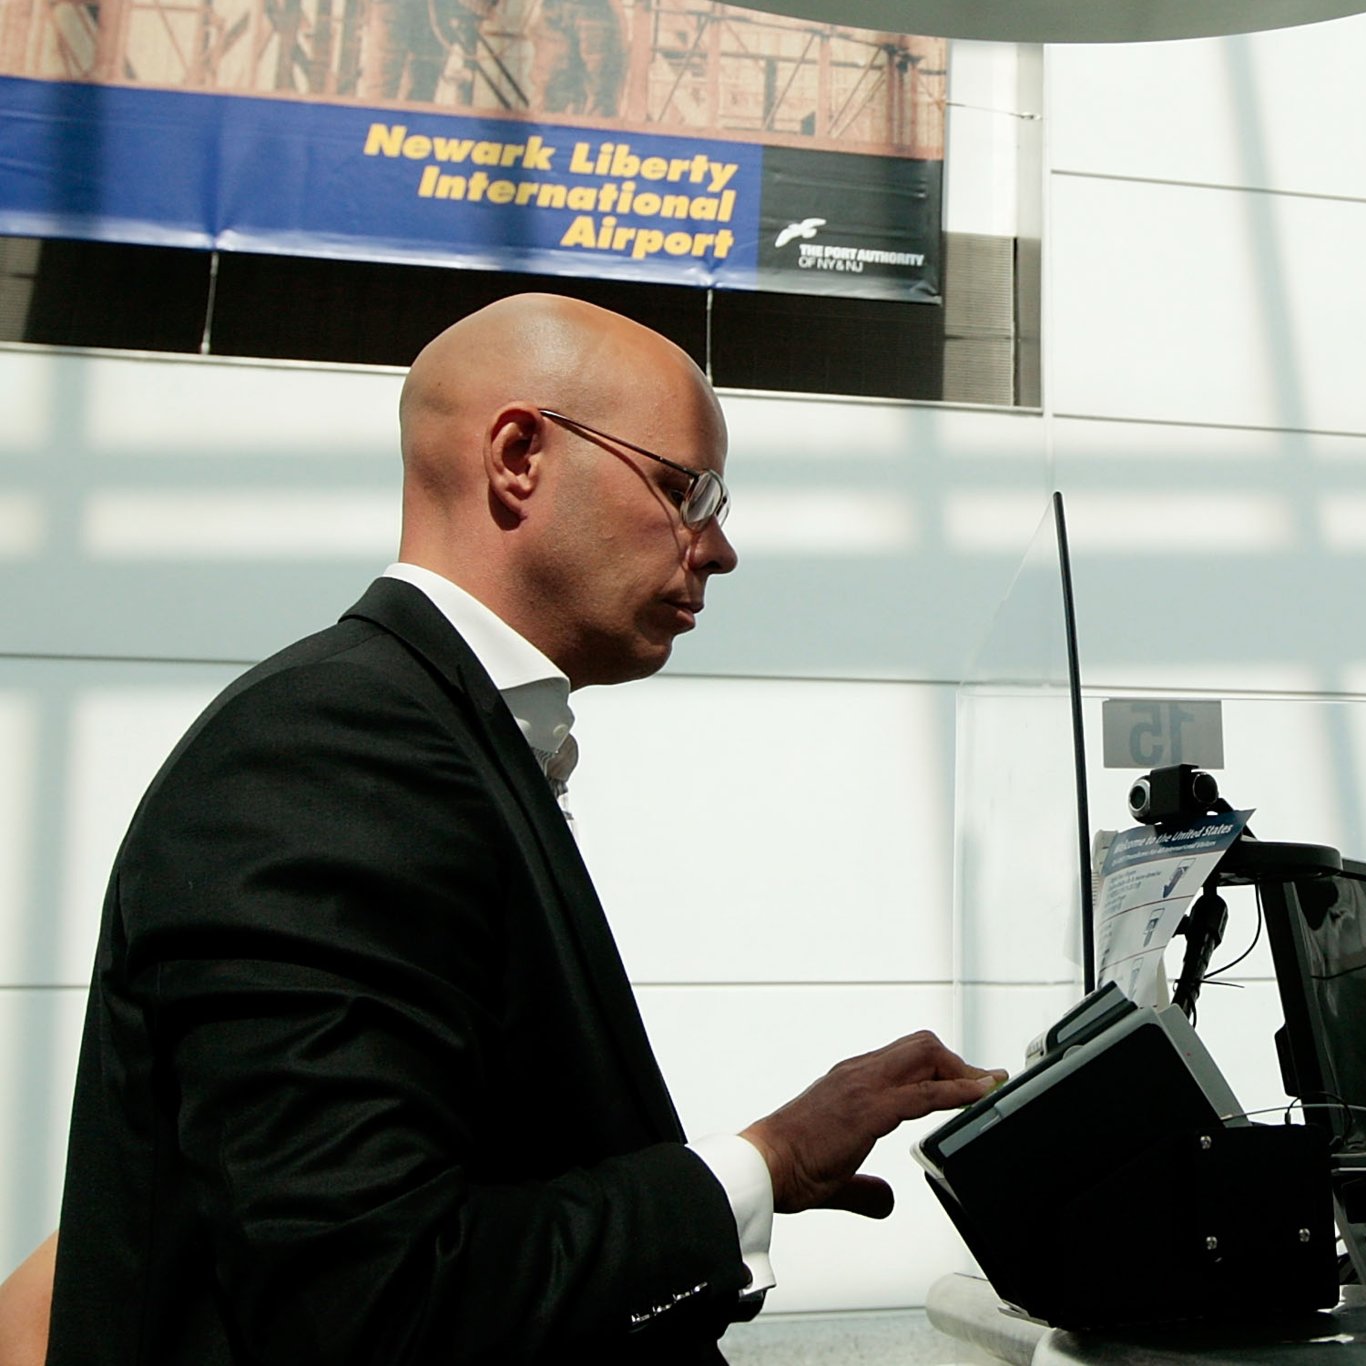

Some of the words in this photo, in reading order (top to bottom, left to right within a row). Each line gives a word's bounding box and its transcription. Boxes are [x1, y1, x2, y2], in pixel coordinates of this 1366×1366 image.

[363, 123, 556, 171] Newark
[568, 142, 739, 193] Liberty
[417, 165, 737, 222] International
[559, 215, 734, 260] Airport
[798, 256, 816, 269] OF
[846, 260, 864, 273] NJ
[799, 243, 824, 257] THE
[824, 245, 857, 261] PORT
[856, 249, 925, 267] AUTHORITY
[1156, 832, 1173, 844] the
[1171, 824, 1206, 841] United
[1202, 822, 1234, 838] States
